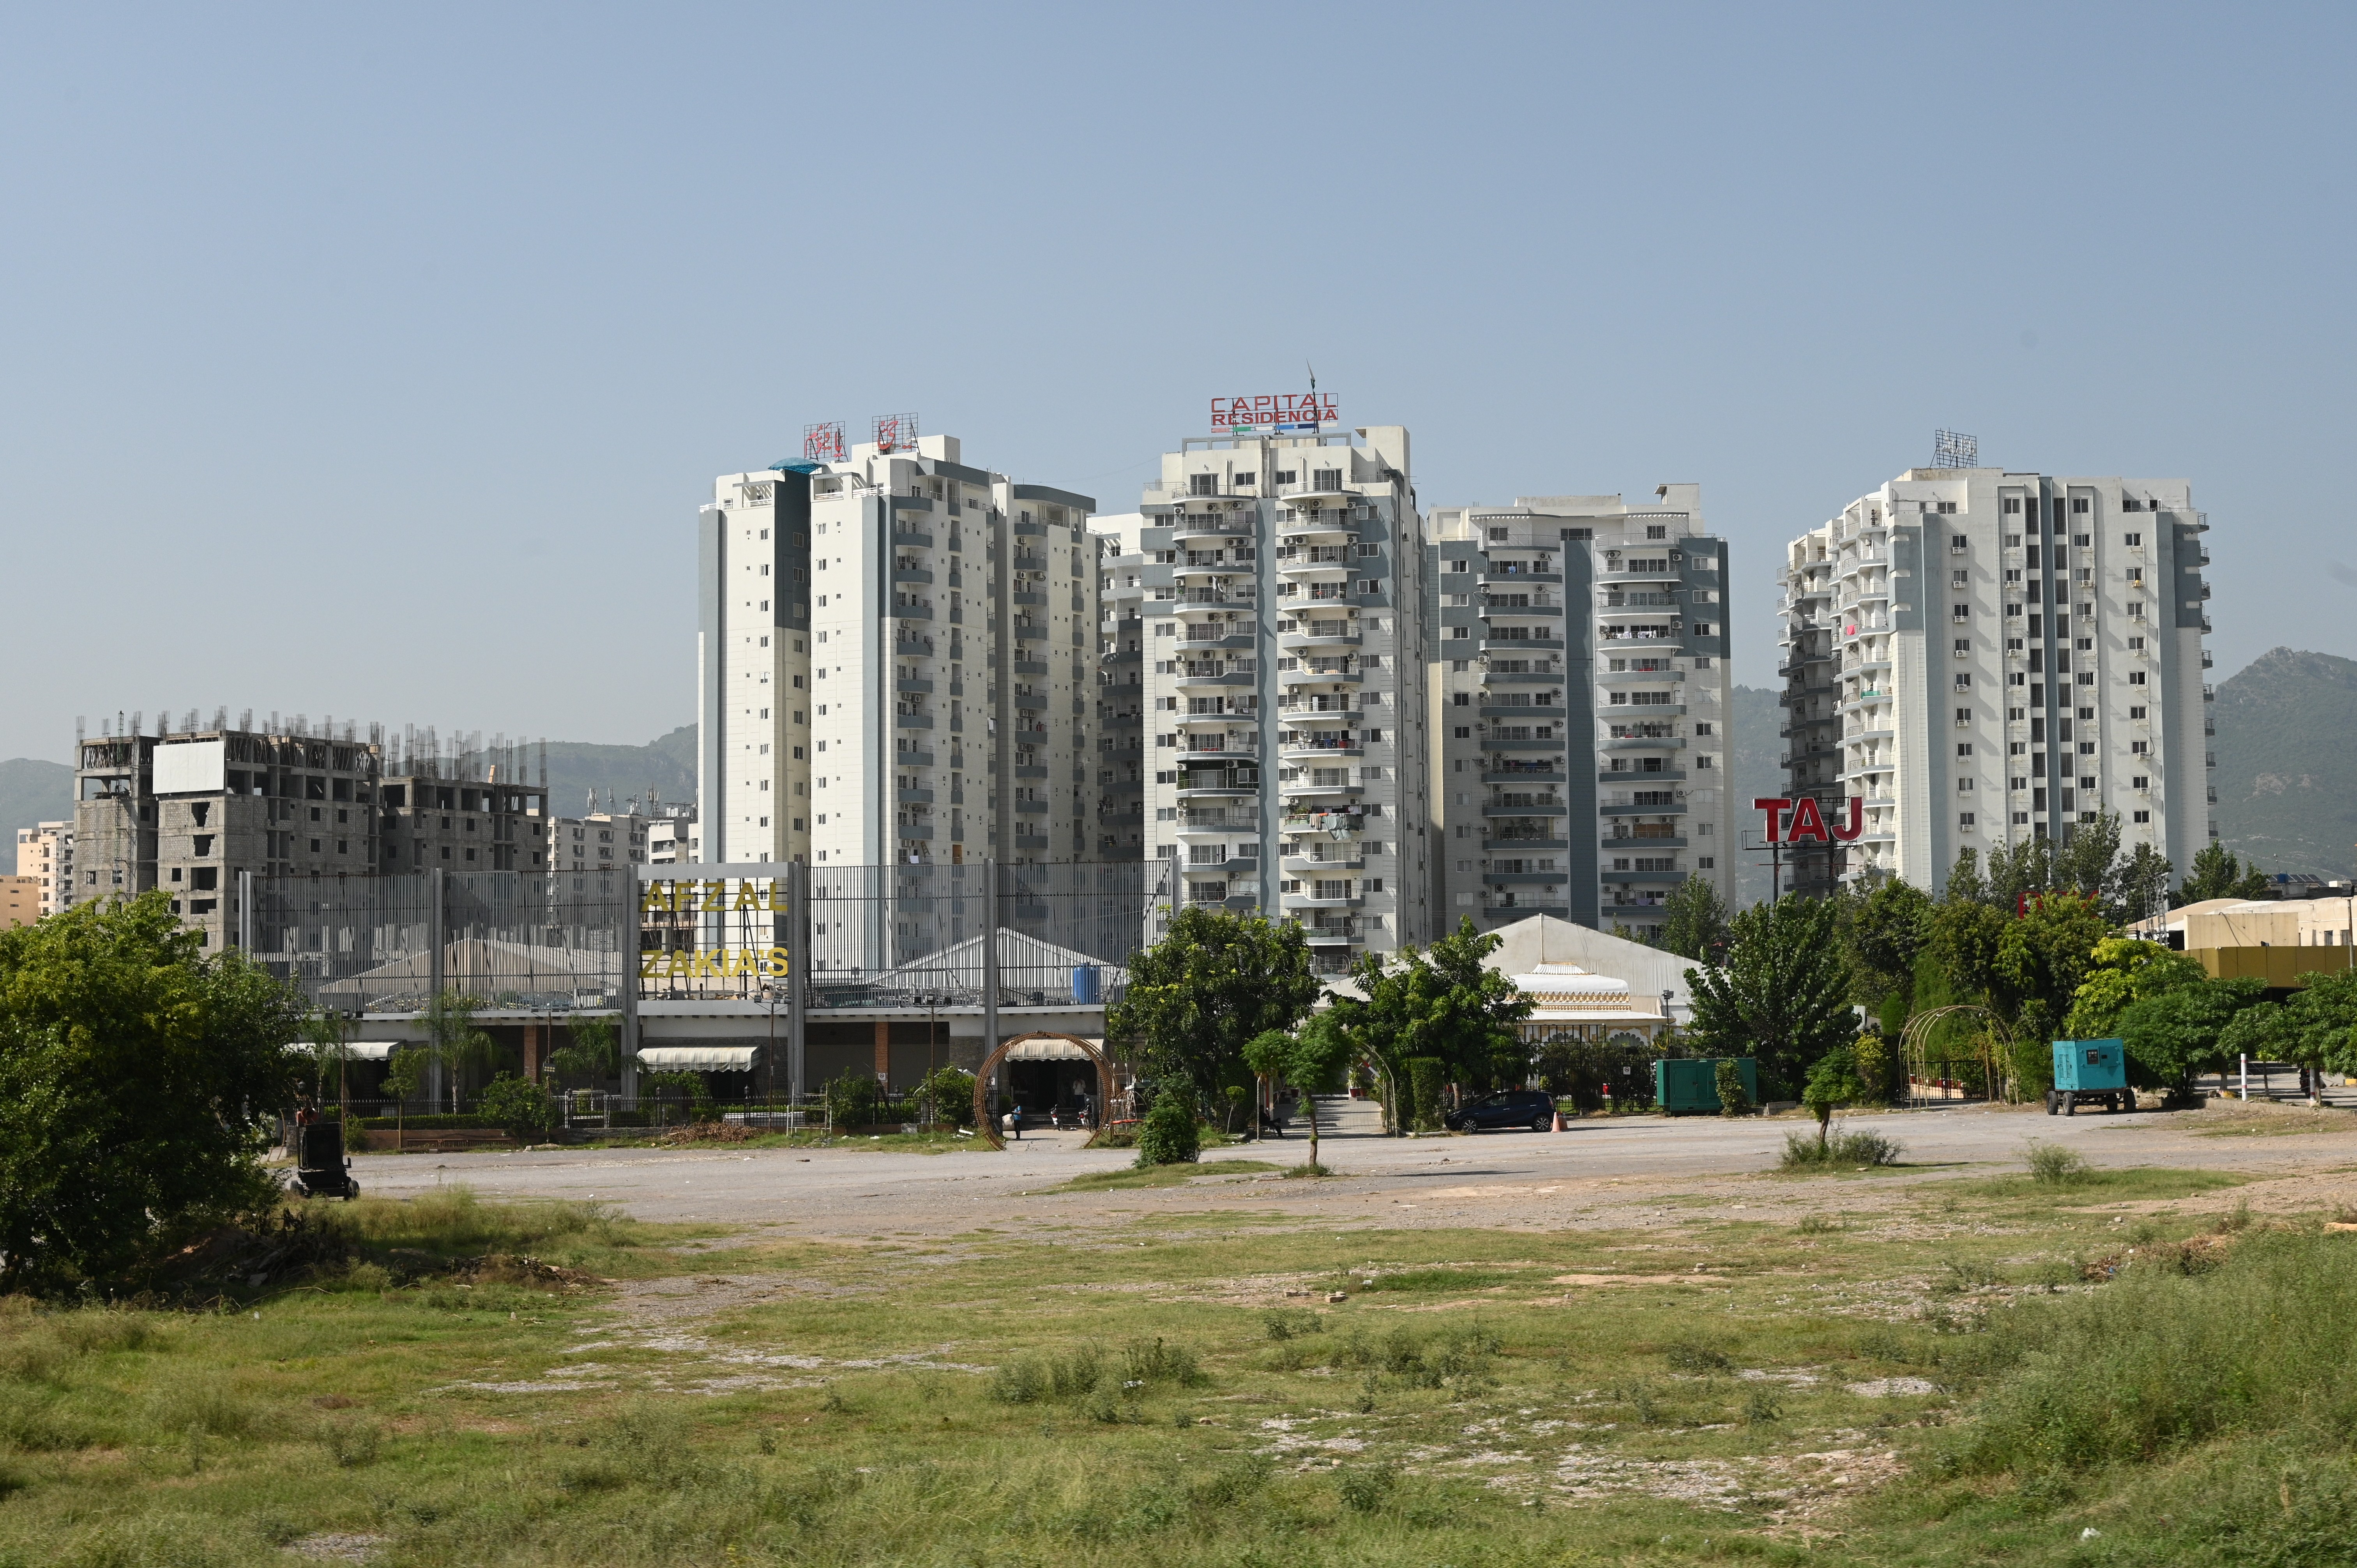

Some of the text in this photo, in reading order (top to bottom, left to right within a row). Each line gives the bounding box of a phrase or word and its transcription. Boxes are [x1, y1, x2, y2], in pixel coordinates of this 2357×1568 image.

[1211, 393, 1337, 413] CAPITAL
[1211, 409, 1338, 426] RESIDENCIA
[1753, 796, 1862, 842] TAJ
[640, 882, 788, 912] AFZAL
[640, 947, 788, 978] ZAKIA'S
